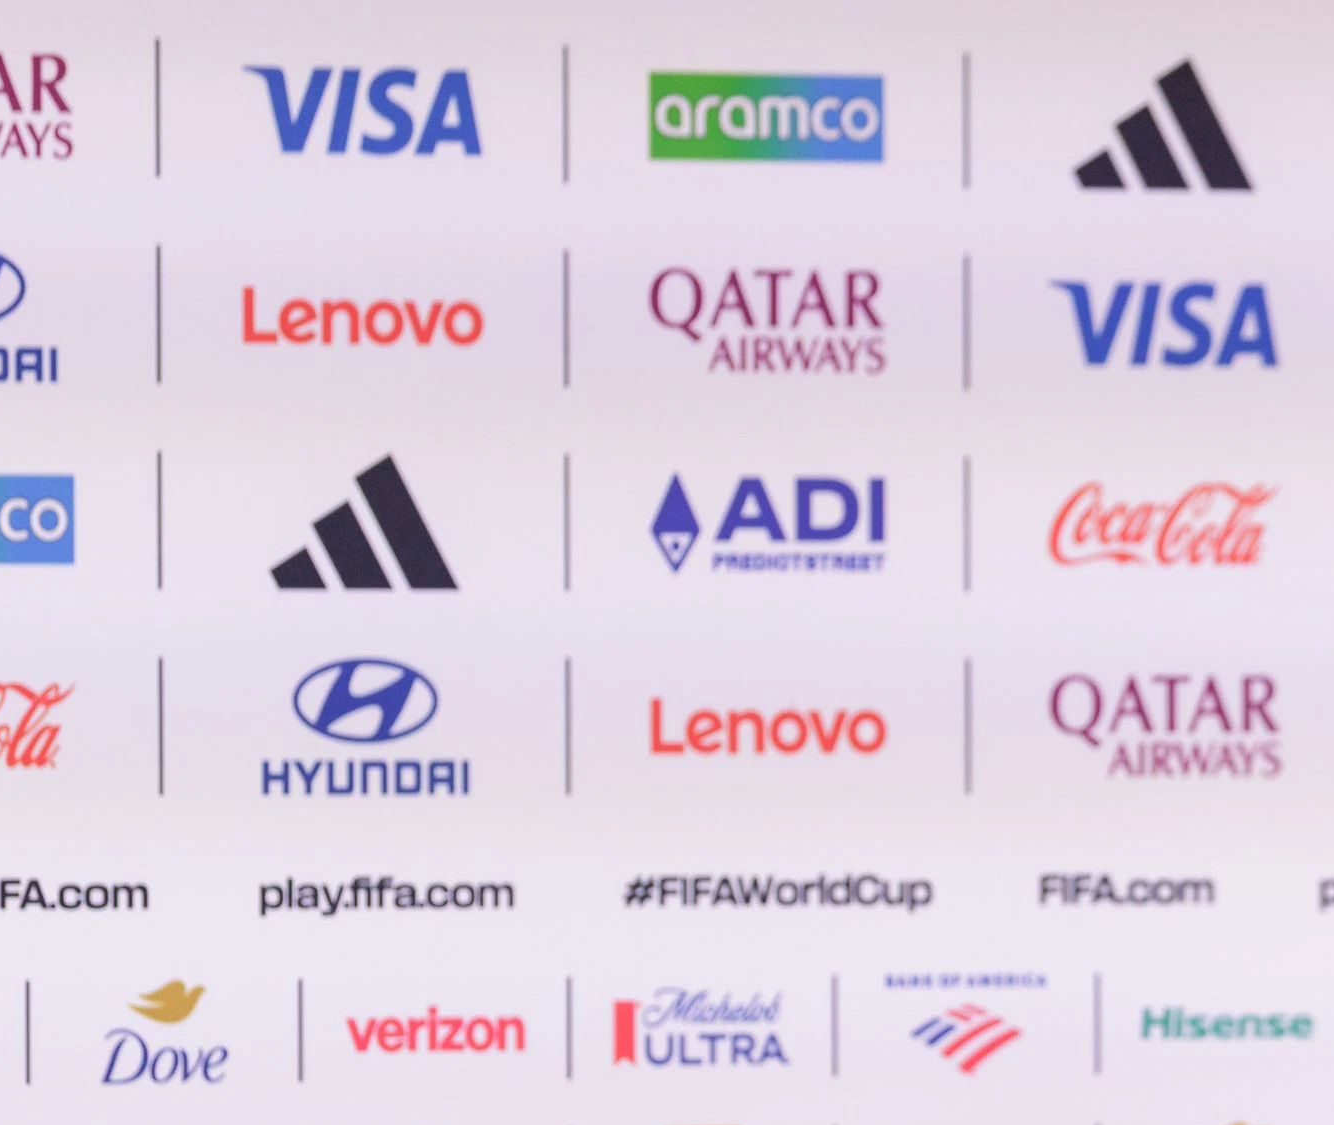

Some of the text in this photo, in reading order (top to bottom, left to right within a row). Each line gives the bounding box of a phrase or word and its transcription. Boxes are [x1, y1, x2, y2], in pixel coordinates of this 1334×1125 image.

[245, 66, 482, 156] VISA
[655, 94, 880, 144] aramco
[243, 286, 484, 346] Lenovo
[649, 268, 884, 344] QATAR
[1055, 281, 1278, 368] VISA
[708, 337, 886, 375] AIRWAYS
[715, 476, 885, 543] ADI
[1048, 482, 1274, 566] Coca-Cola
[650, 698, 887, 755] Lenovo
[1048, 674, 1280, 747] QATAR
[262, 760, 469, 796] HYUNDAI
[1108, 744, 1284, 779] AIRWAYS
[260, 877, 514, 916] play.fifa.com
[624, 874, 933, 912] #FIFAWorldCup
[1038, 873, 1215, 906] FIFA.com
[347, 1006, 525, 1053] verizon
[641, 984, 785, 1028] Michelob
[1141, 1008, 1314, 1040] Hisense
[102, 1022, 228, 1084] Dove
[643, 1030, 793, 1068] ULTRA
